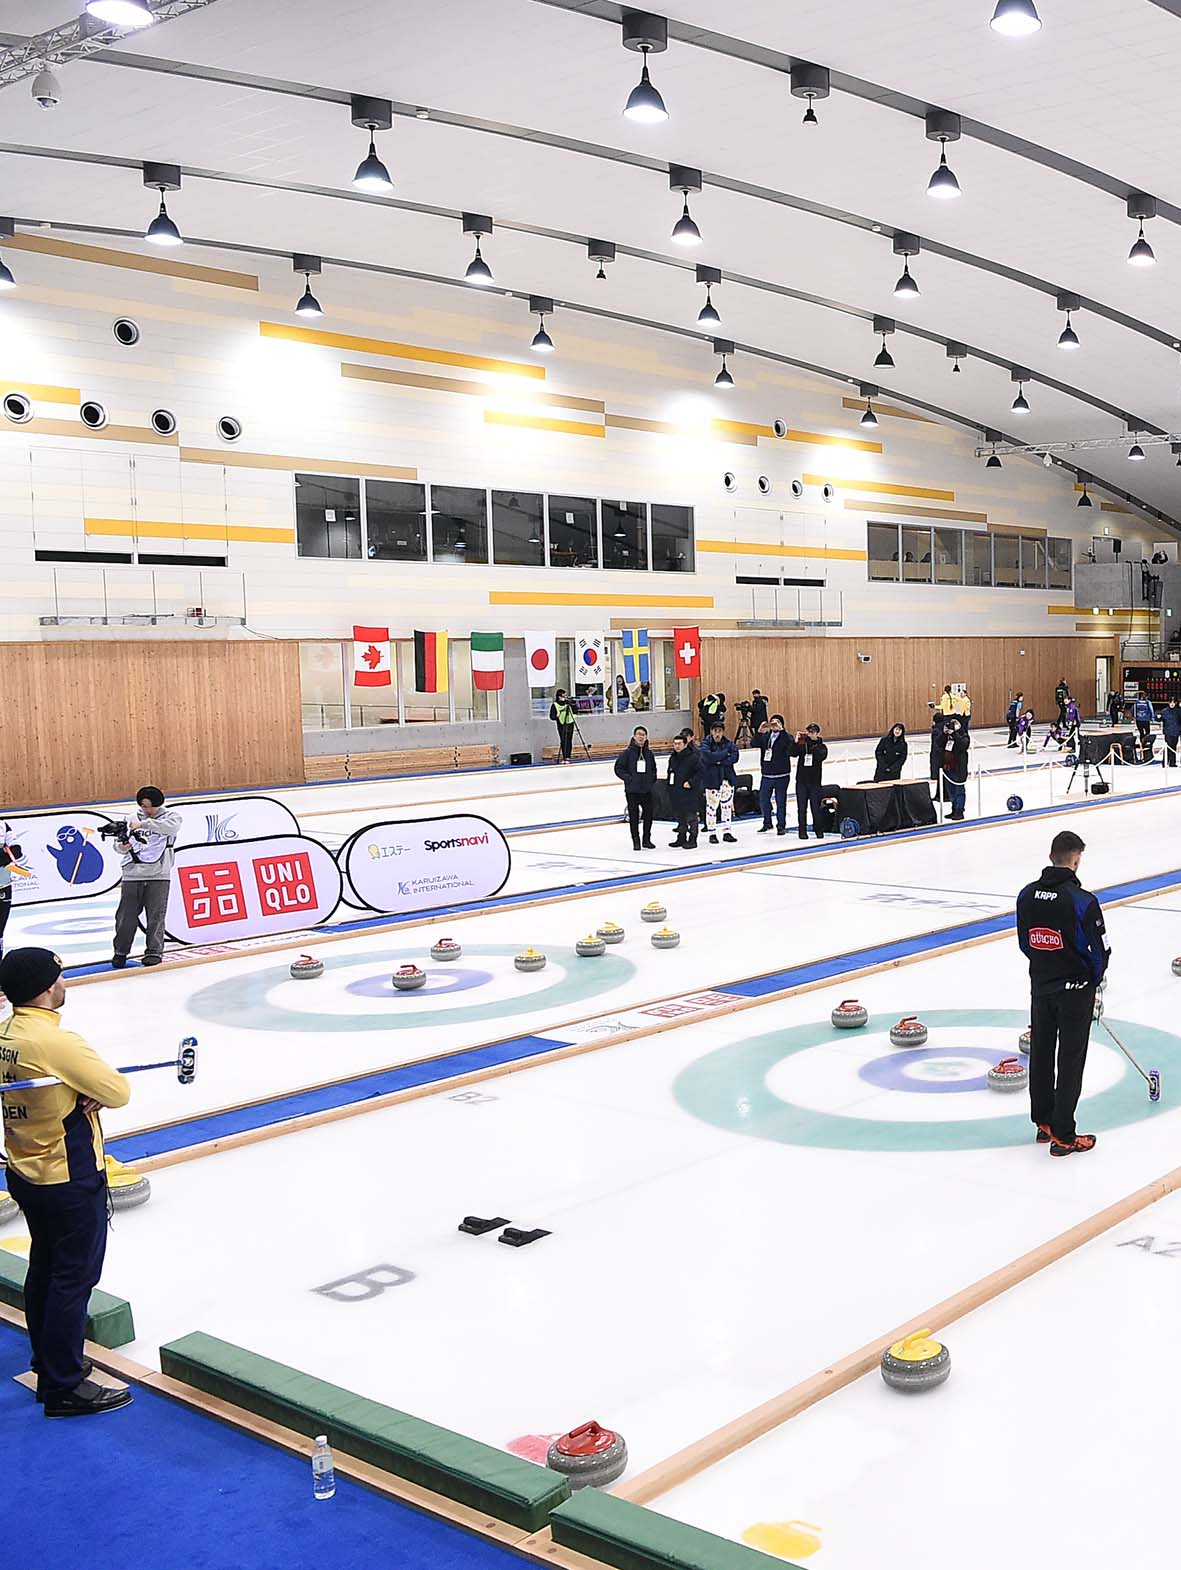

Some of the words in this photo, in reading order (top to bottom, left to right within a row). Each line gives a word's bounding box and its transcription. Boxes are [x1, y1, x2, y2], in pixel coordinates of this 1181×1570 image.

[424, 832, 489, 852] Sportsnavi
[382, 845, 411, 858] エステー
[412, 874, 458, 885] KARUIZAWA
[413, 880, 474, 893] INTERNATIONAL
[1035, 890, 1058, 901] KAPP
[448, 1091, 499, 1105] B2
[3, 1105, 28, 1120] DEN
[308, 1263, 416, 1303] B
